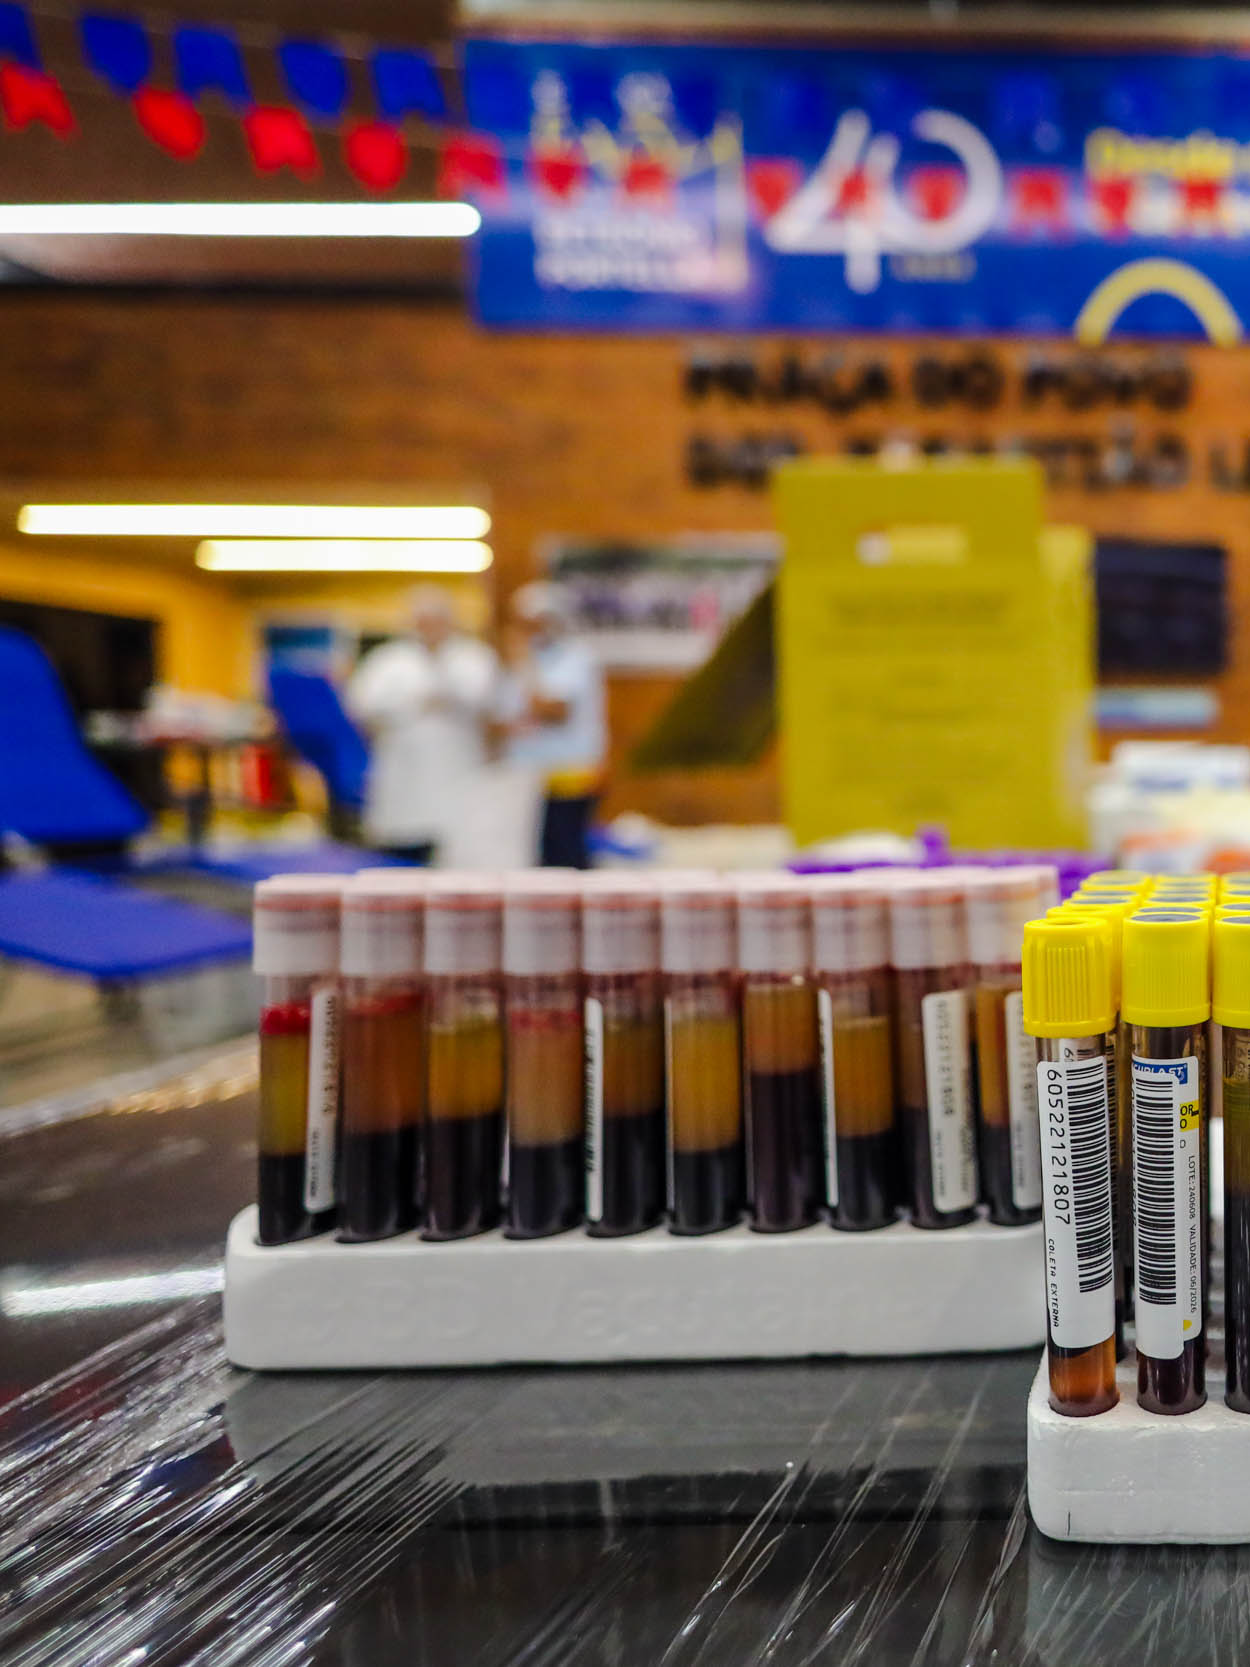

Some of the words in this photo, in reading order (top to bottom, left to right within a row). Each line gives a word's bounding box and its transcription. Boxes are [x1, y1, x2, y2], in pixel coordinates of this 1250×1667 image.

[1047, 1070, 1070, 1225] 60522121807
[1188, 1155, 1196, 1184] LOTE:
[1189, 1186, 1197, 1220] 240608
[1048, 1238, 1056, 1277] COLETA
[1050, 1283, 1059, 1328] EXTERNA
